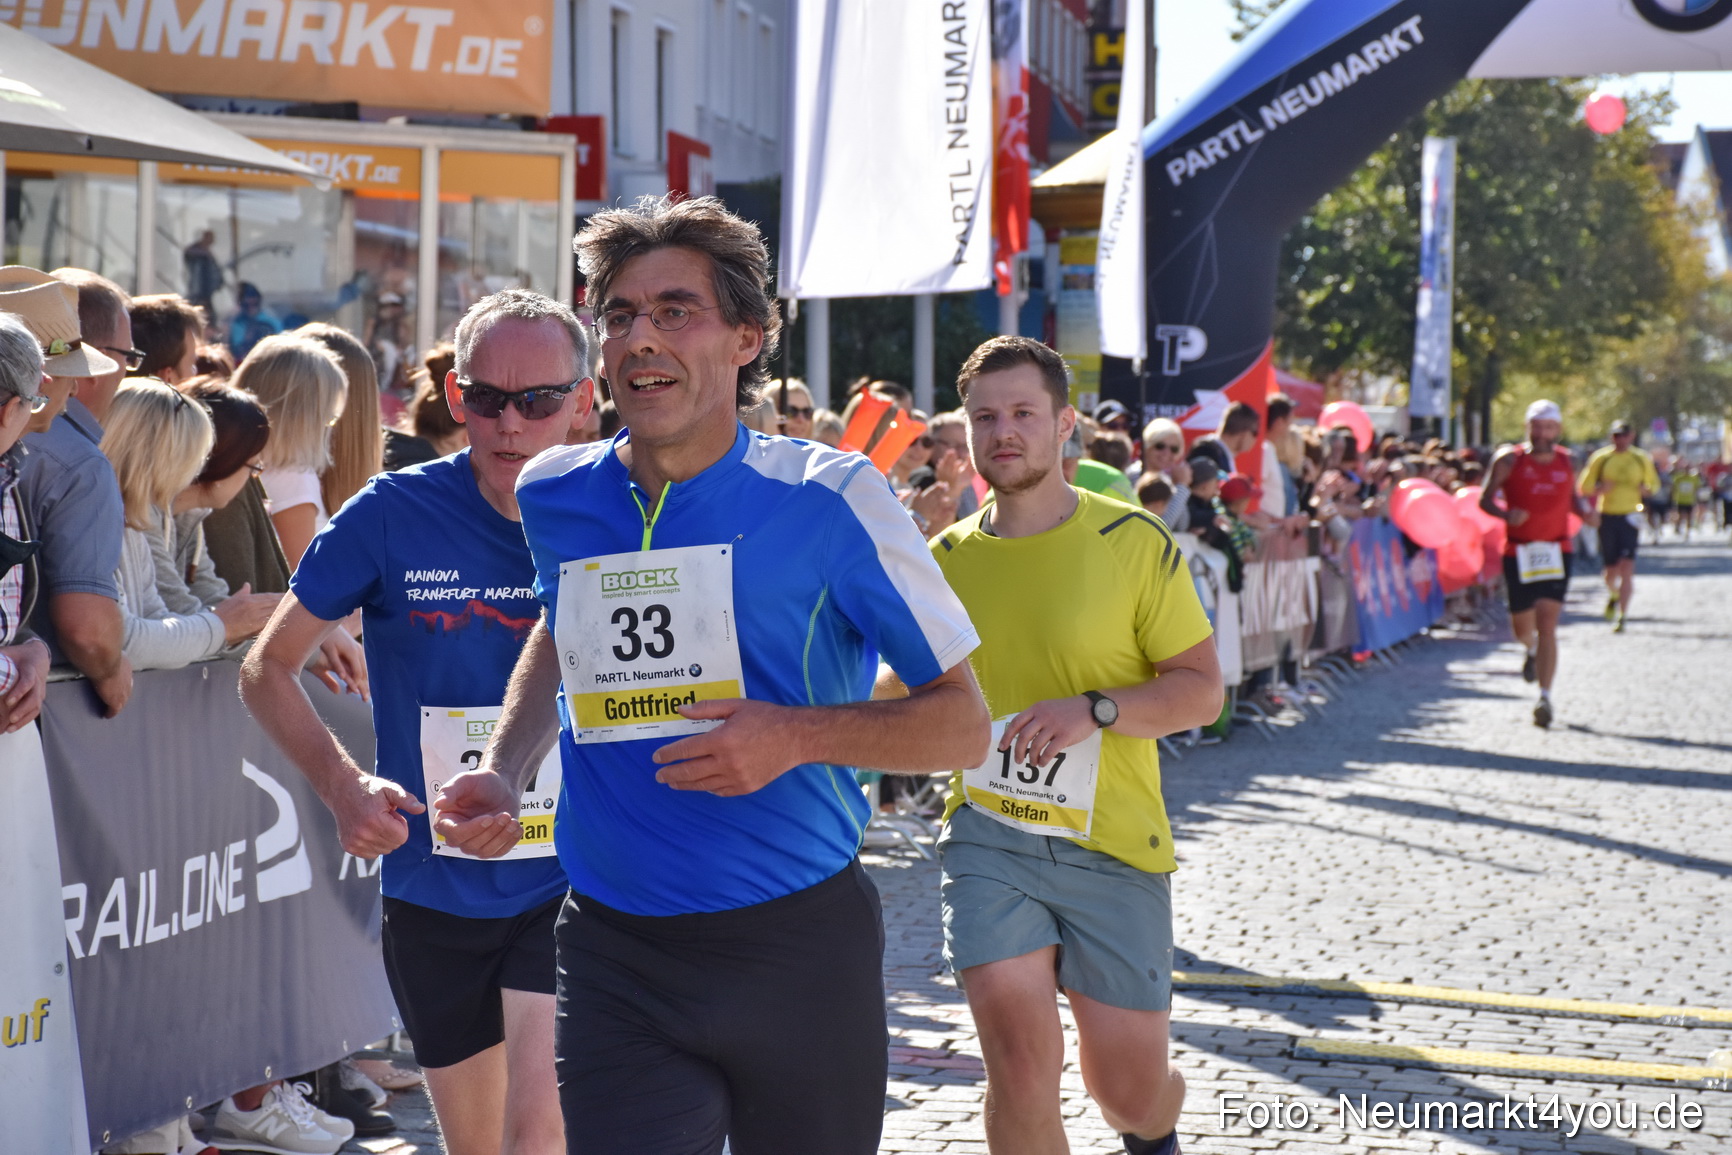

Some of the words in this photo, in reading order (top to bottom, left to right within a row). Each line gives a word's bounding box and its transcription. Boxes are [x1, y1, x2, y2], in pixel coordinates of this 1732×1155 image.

[0, 0, 523, 79] UNMARKT.DE
[1166, 118, 1265, 187] PARTL
[1258, 14, 1425, 132] NEUMARKT
[404, 568, 460, 583] MAINOVA
[601, 568, 680, 592] BOCK
[405, 586, 481, 601] FRANKFURT
[601, 590, 625, 599] inspired
[653, 587, 681, 596] concepts
[611, 604, 675, 662] 33
[595, 672, 631, 685] PARTL
[633, 667, 685, 681] Neumarkt
[604, 690, 697, 721] Gottfried
[997, 746, 1067, 787] 137
[988, 780, 1014, 794] PARTL
[1015, 787, 1055, 801] Neumarkt
[1001, 799, 1049, 822] Stefan
[62, 838, 247, 960] RAIL.ONE
